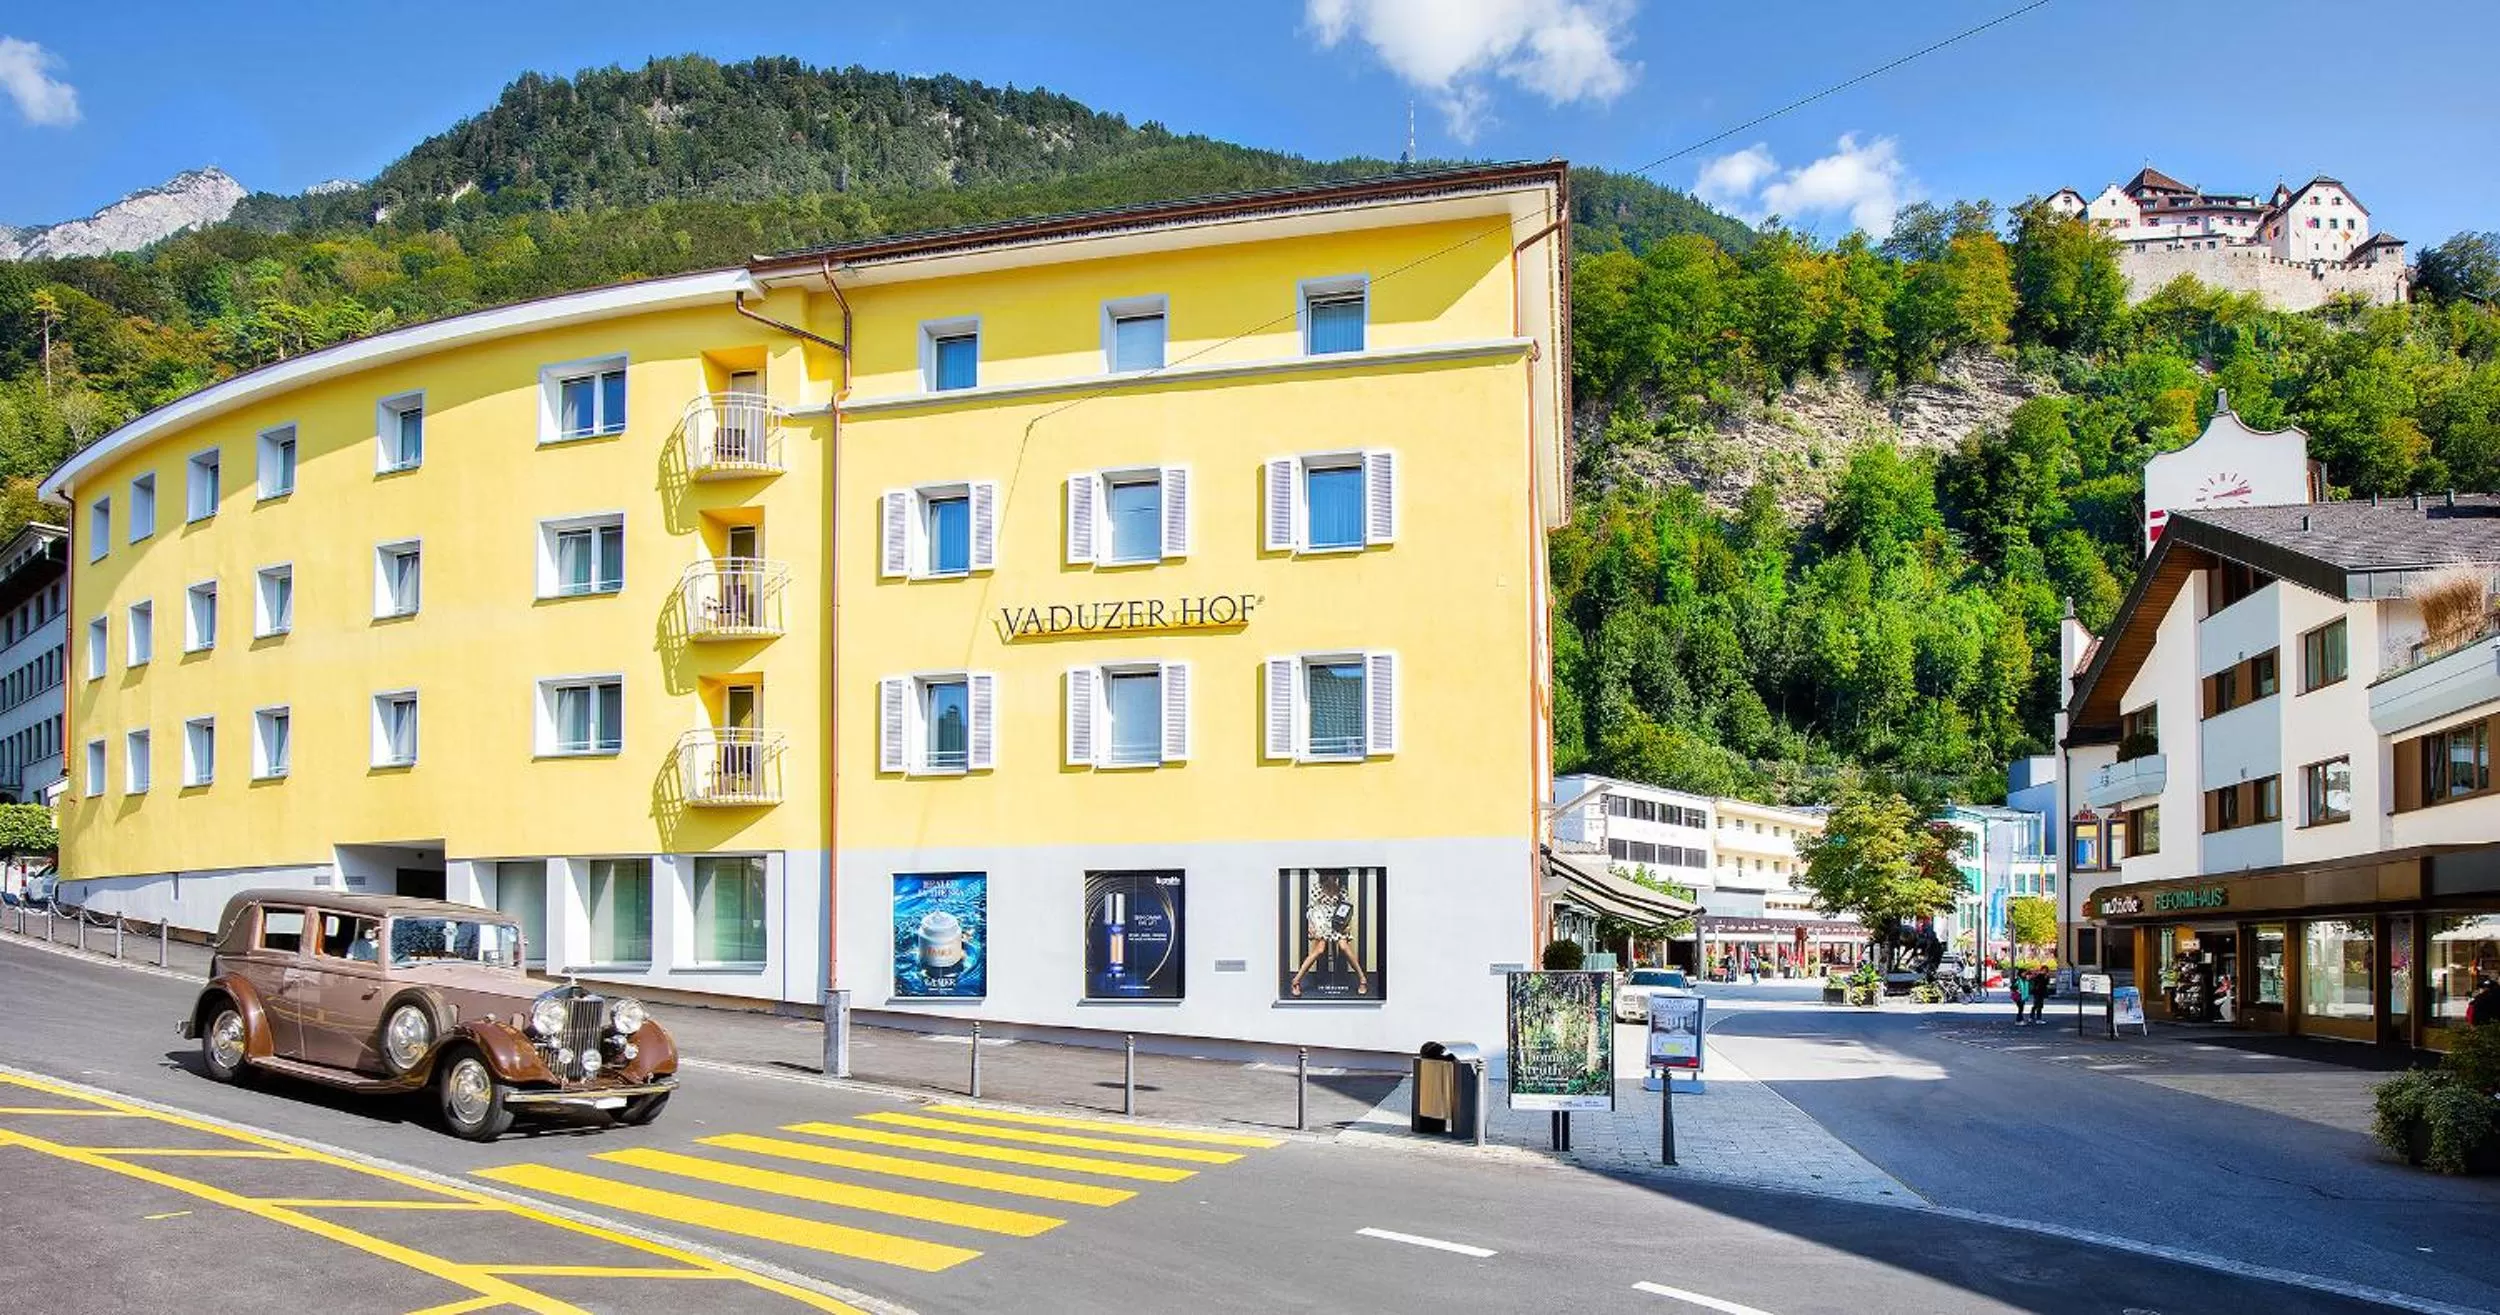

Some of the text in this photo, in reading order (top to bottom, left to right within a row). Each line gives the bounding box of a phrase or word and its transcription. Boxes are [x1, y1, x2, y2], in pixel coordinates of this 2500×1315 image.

[1001, 594, 1256, 636] VADUZER HOF
[2154, 887, 2224, 910] REFORMHAUS
